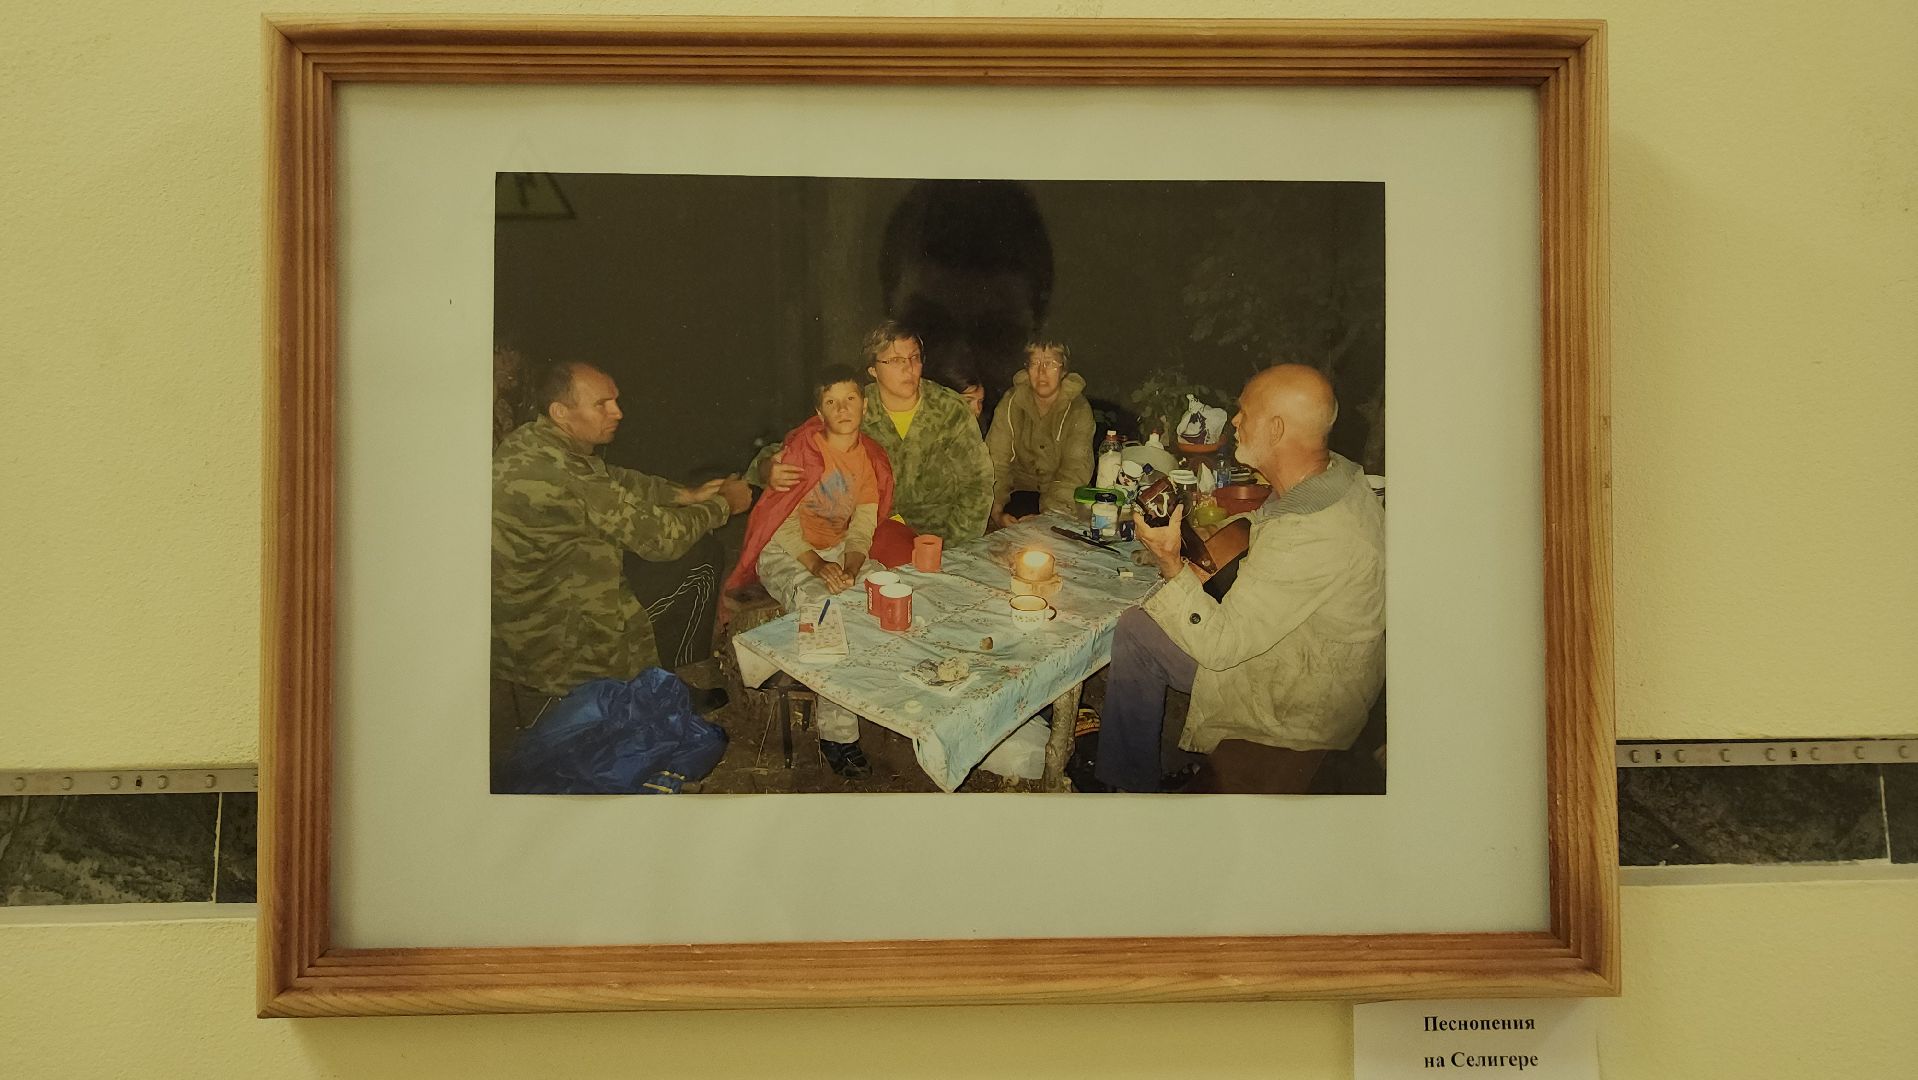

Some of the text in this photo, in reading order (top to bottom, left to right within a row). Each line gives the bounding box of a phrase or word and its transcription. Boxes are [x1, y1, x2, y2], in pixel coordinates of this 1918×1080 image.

[1423, 1016, 1536, 1032] Песнопения
[1424, 1052, 1539, 1071] на Селигере
